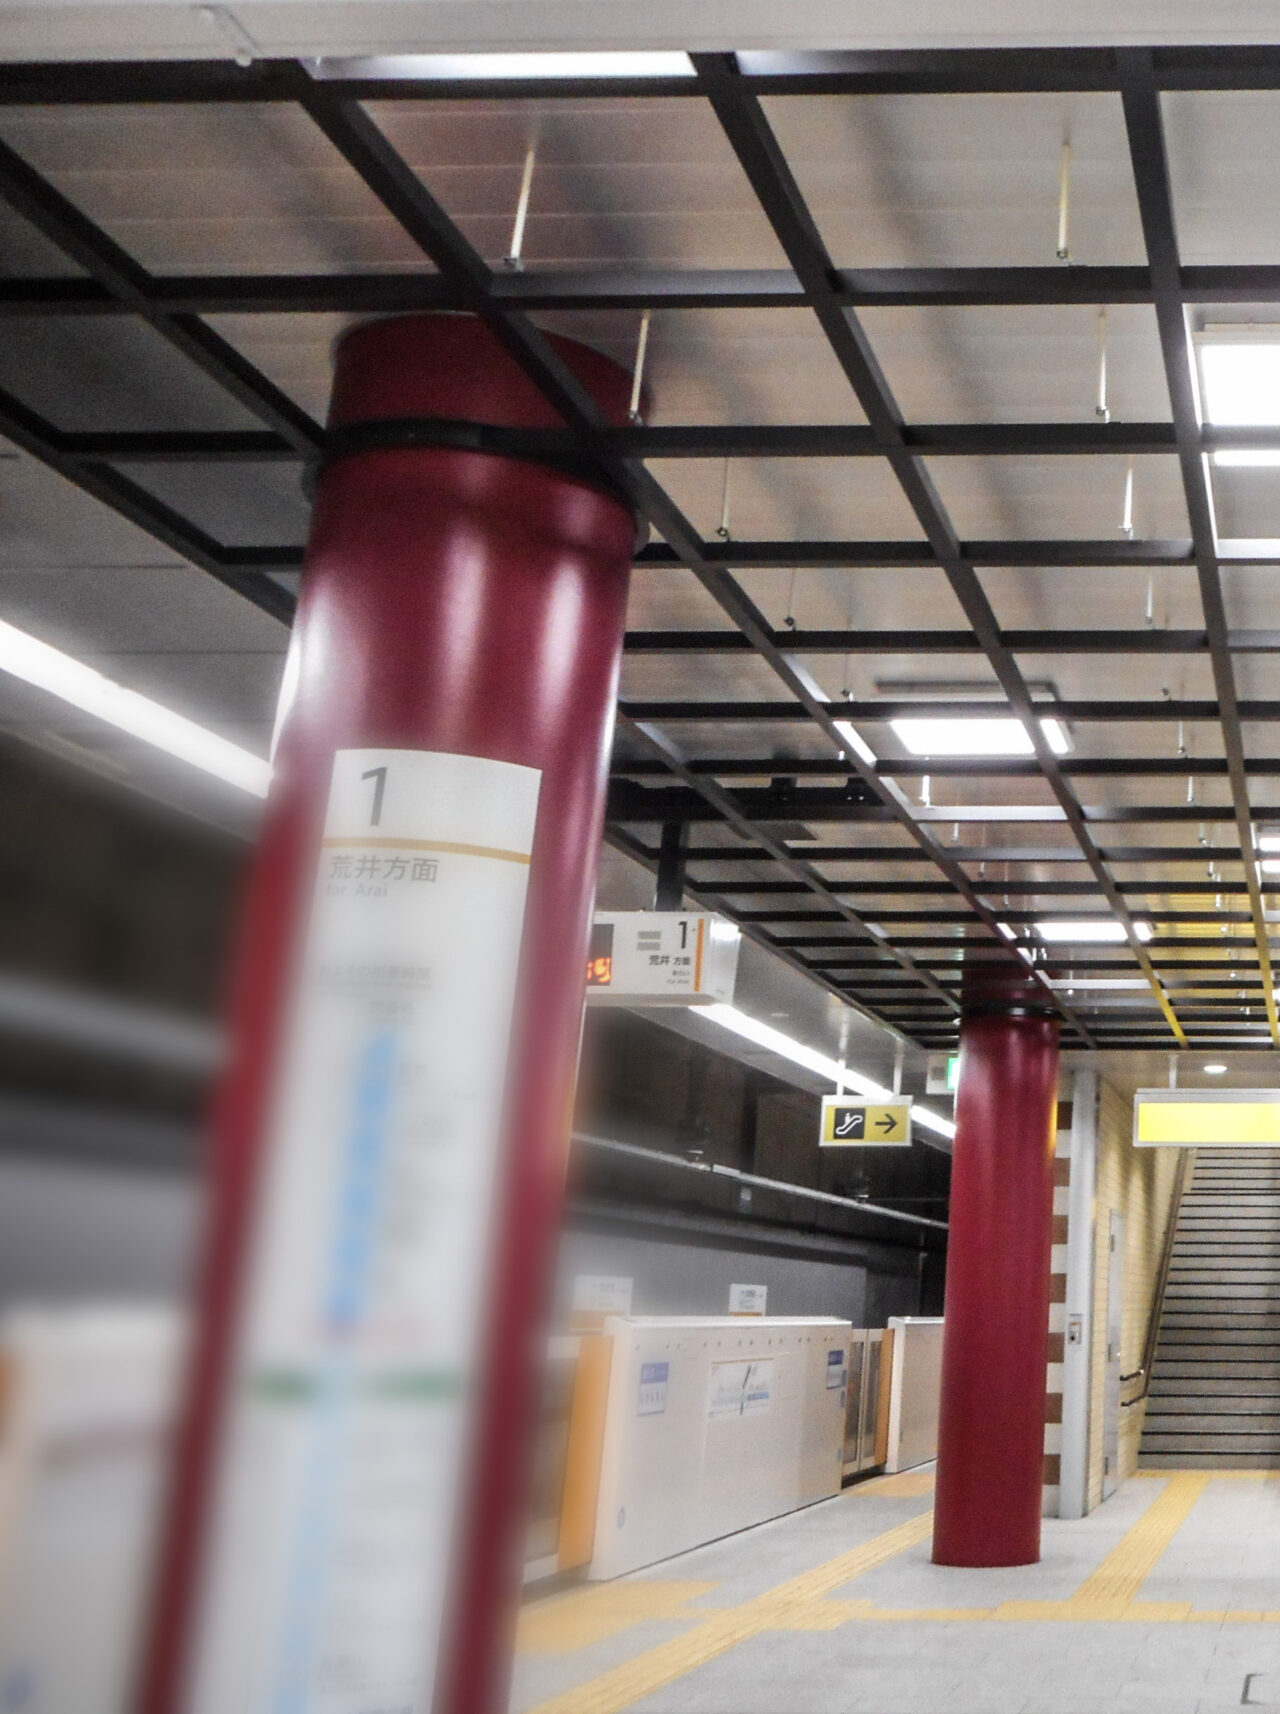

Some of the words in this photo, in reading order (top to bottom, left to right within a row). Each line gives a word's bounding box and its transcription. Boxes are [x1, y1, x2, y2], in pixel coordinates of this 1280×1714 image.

[361, 766, 388, 827] 1
[328, 854, 440, 883] 荒井方面
[354, 883, 388, 897] Arai
[678, 920, 688, 949] 1
